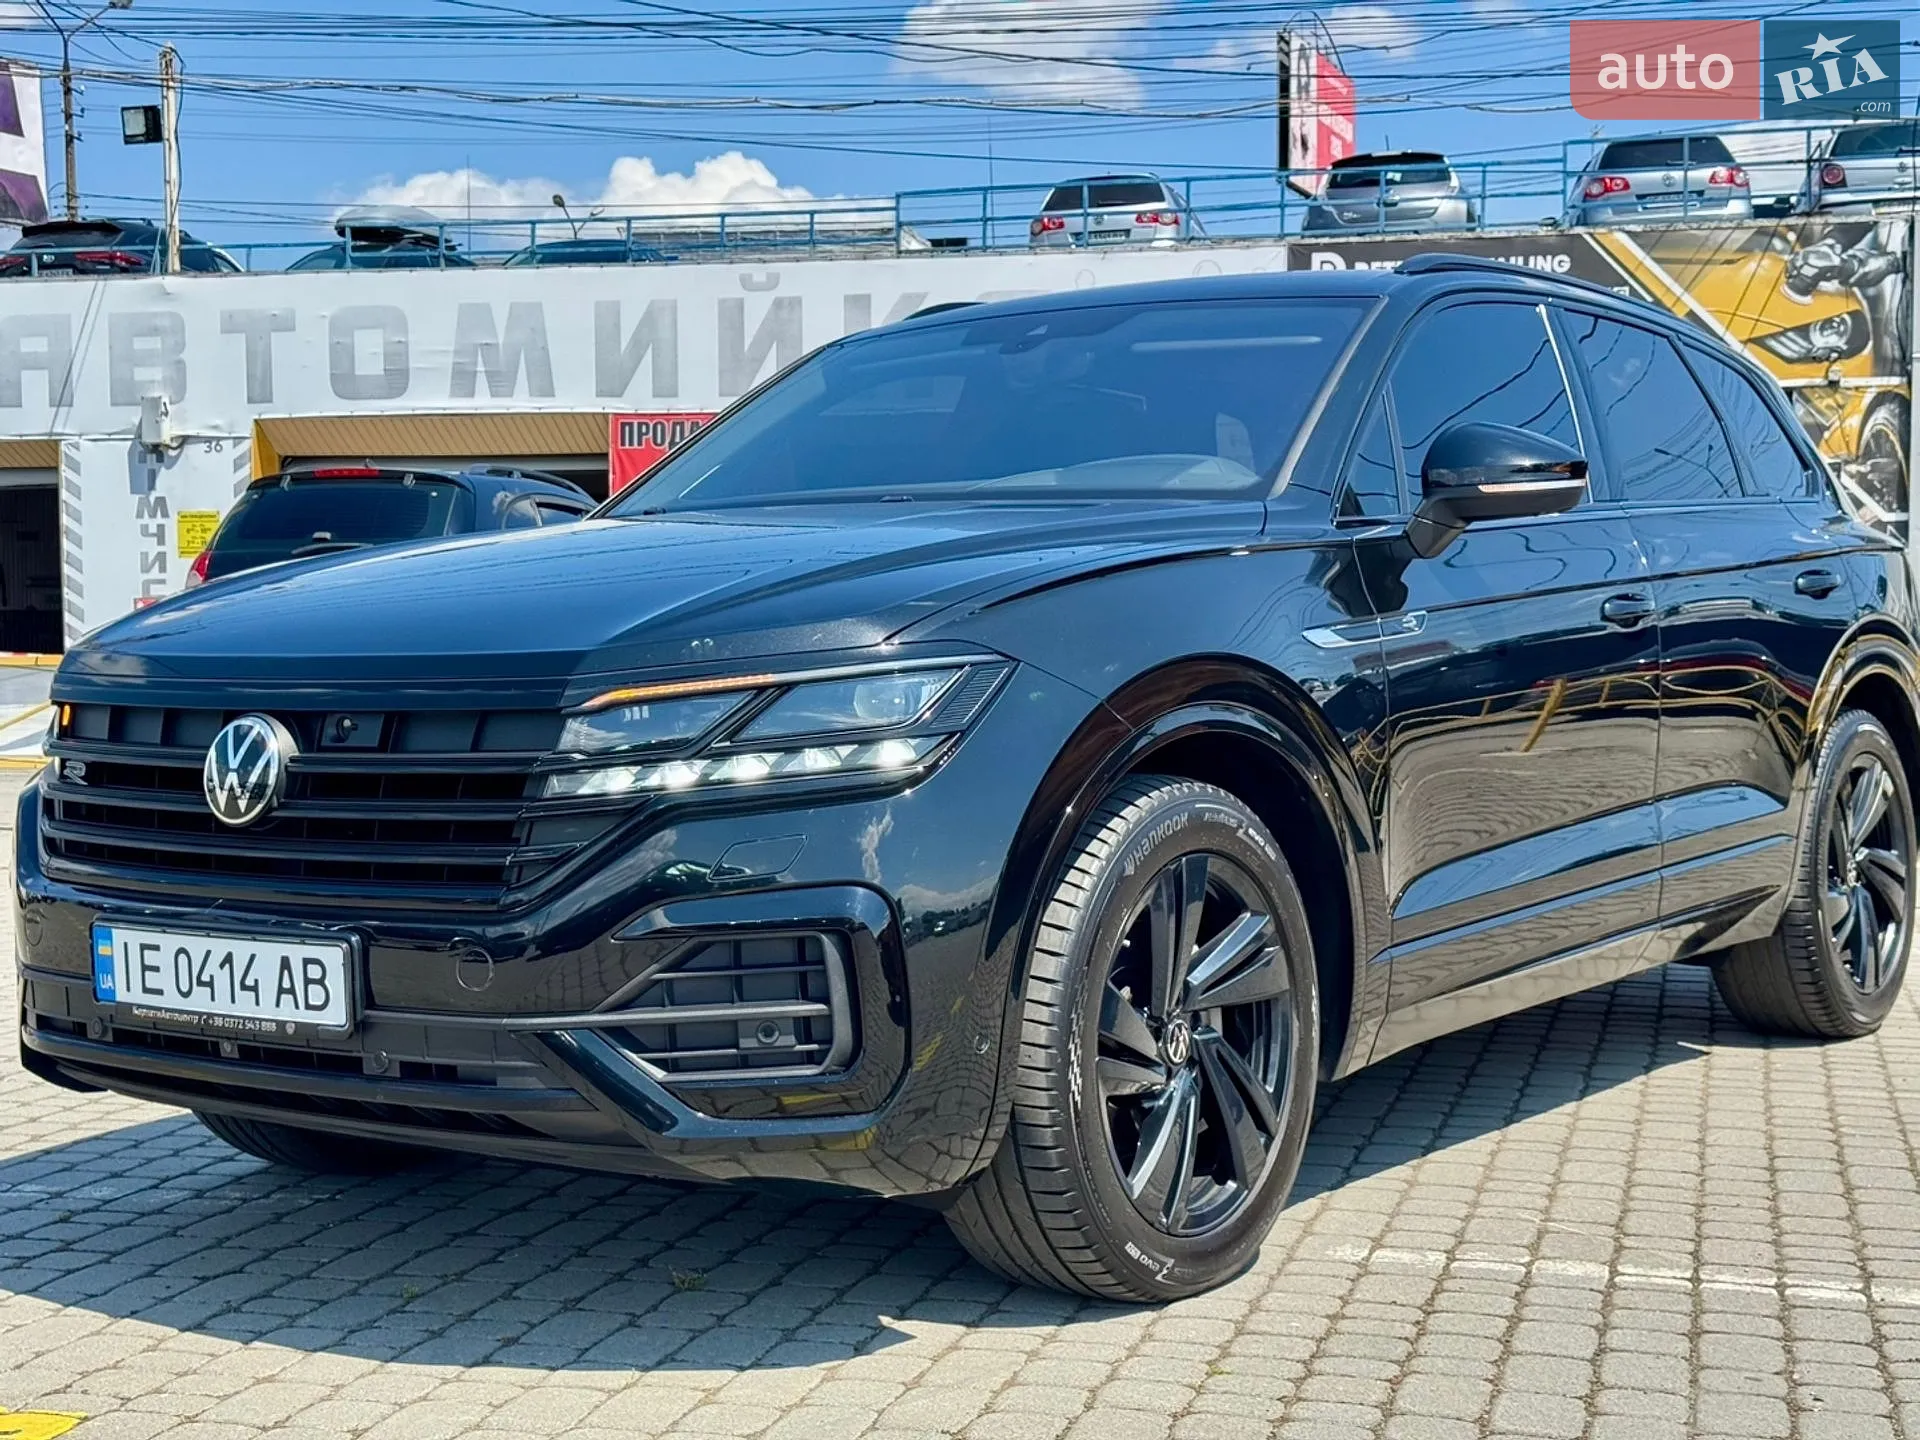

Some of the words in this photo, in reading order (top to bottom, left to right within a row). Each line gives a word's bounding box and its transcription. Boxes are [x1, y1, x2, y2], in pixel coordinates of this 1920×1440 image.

[203, 440, 223, 453] 36
[63, 761, 88, 785] R
[100, 973, 114, 989] UA
[123, 941, 164, 996] IE
[174, 946, 260, 1007] 0414
[275, 955, 331, 1012] AB
